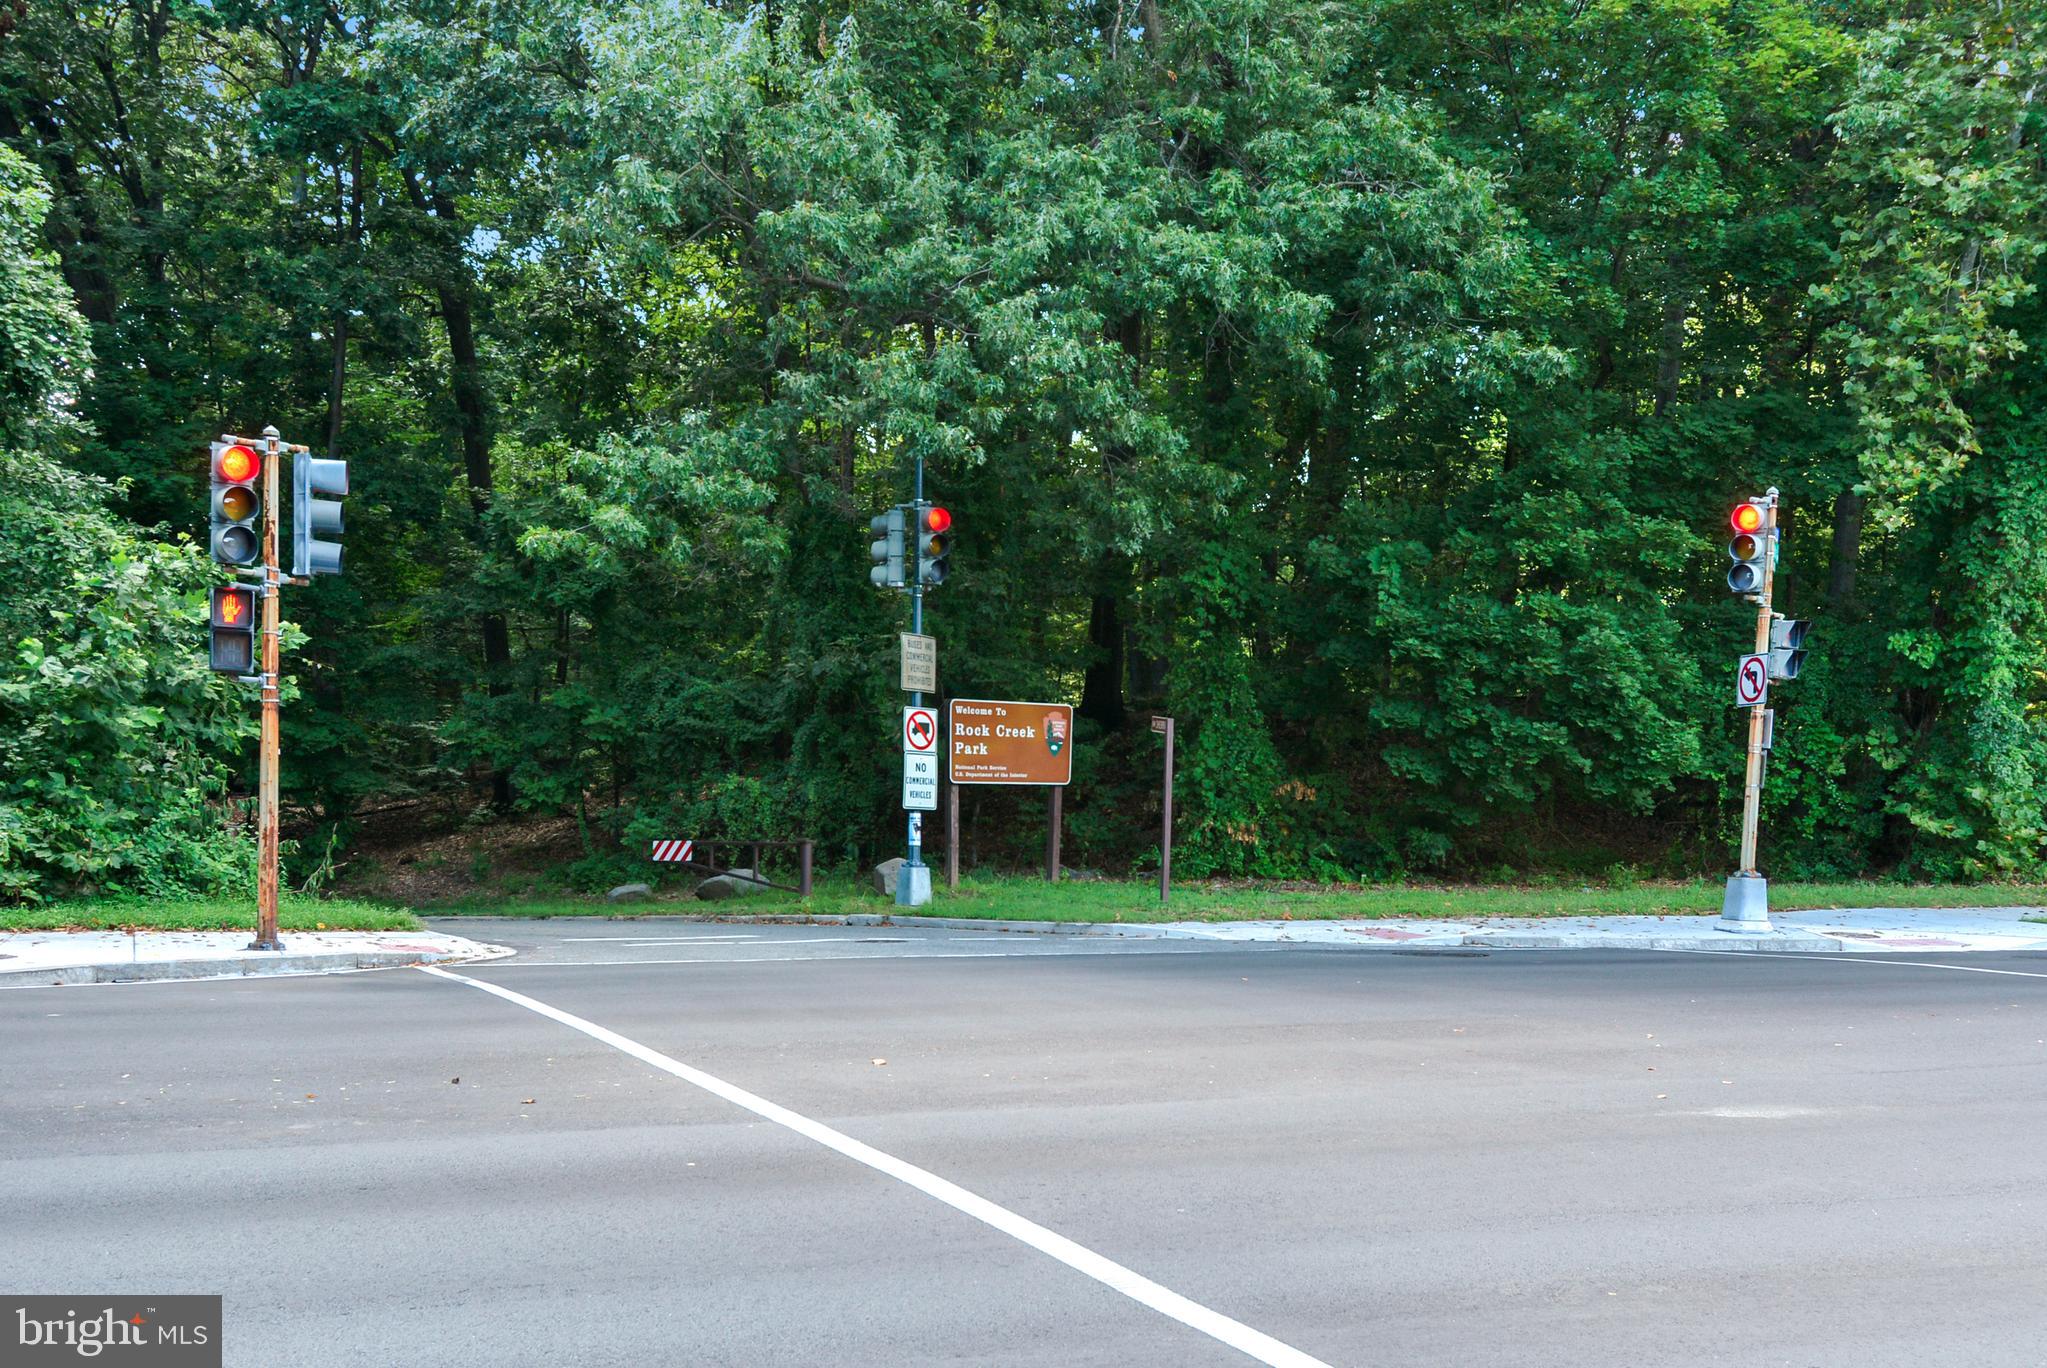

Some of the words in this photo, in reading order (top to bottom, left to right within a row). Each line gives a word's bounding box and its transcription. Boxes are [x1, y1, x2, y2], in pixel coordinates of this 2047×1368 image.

[955, 705, 993, 716] Welcome
[995, 707, 1007, 716] To
[955, 723, 990, 737] Rock
[996, 724, 1036, 738] Creek
[955, 742, 988, 755] Park
[915, 762, 927, 773] NO
[905, 776, 936, 786] COMMERCIAL
[909, 790, 932, 800] VEHICLES
